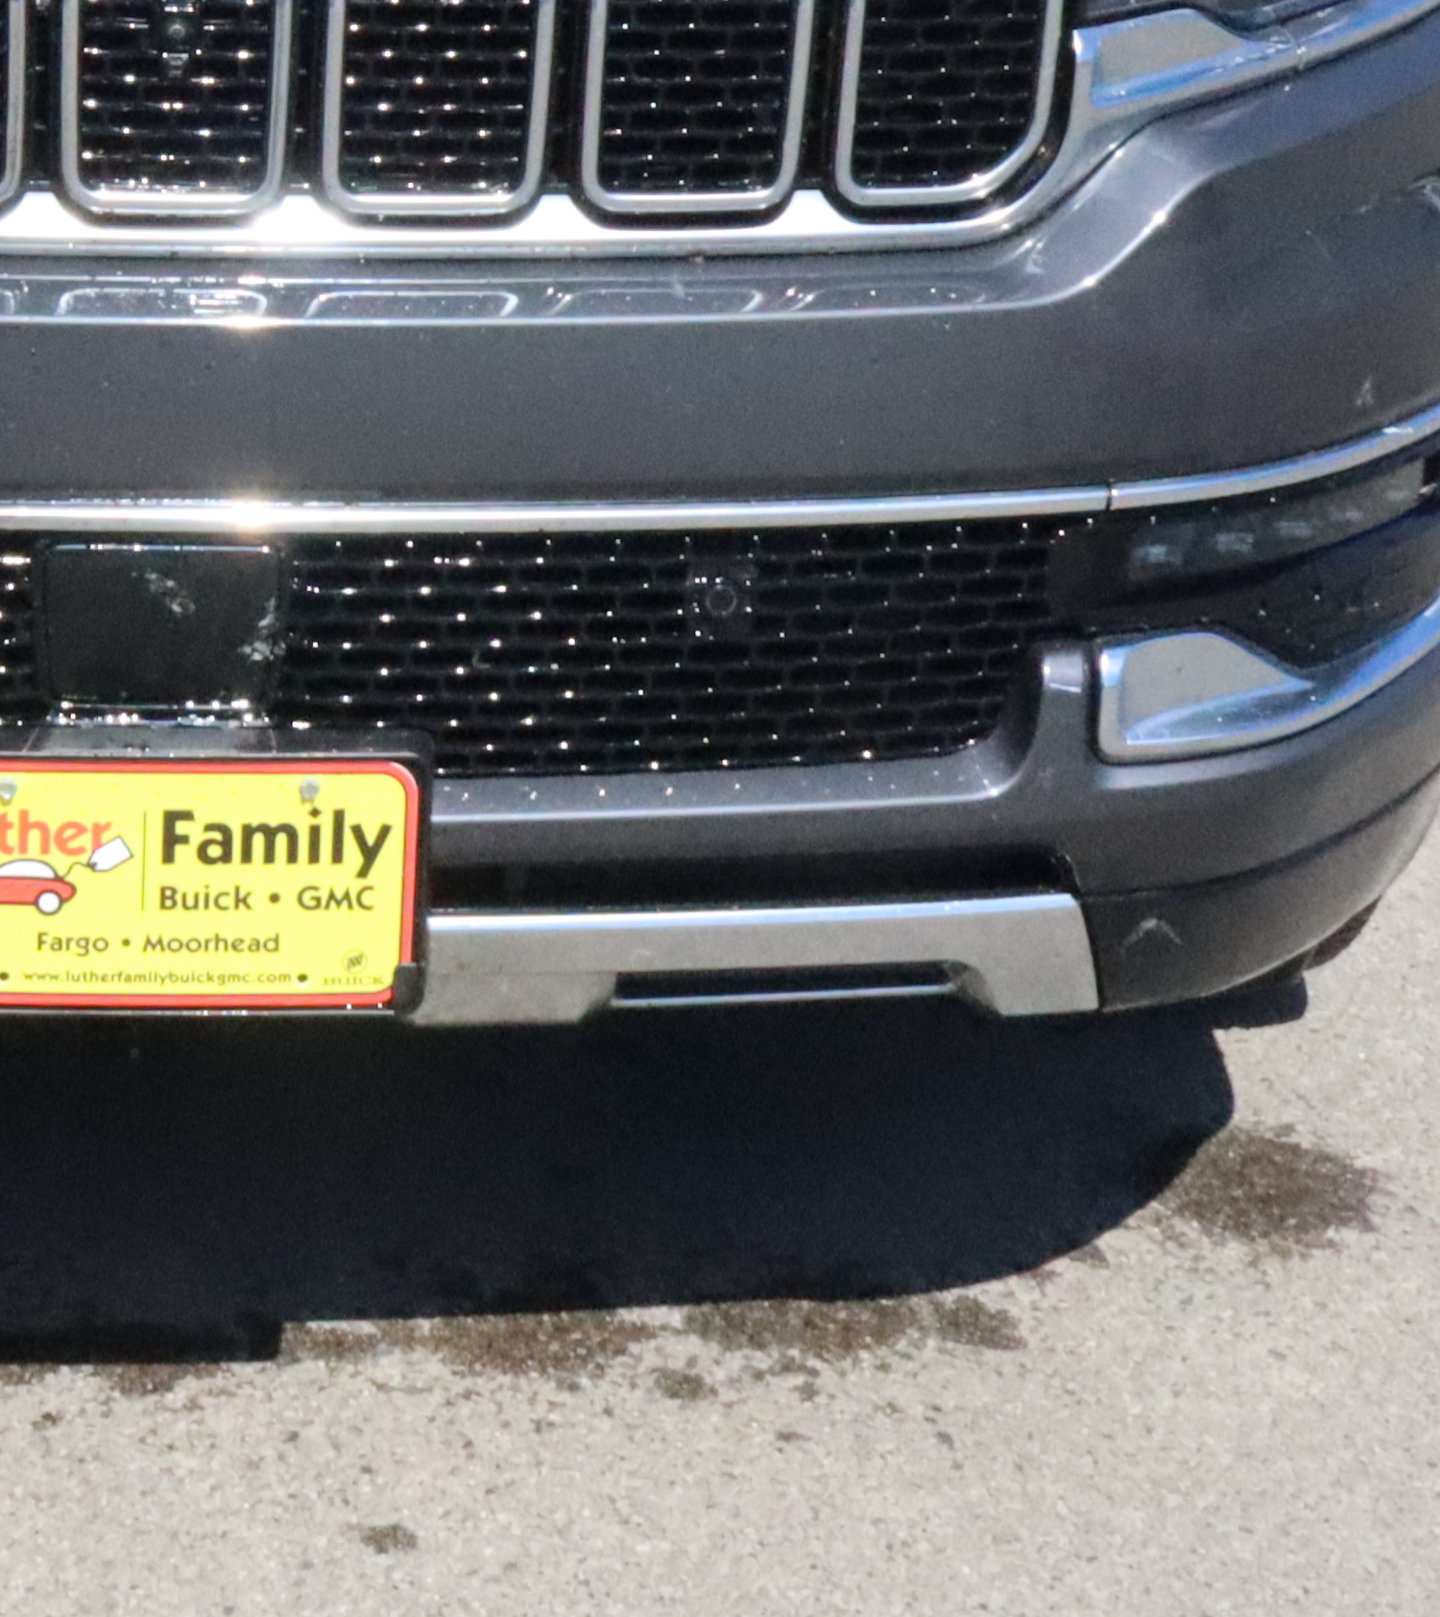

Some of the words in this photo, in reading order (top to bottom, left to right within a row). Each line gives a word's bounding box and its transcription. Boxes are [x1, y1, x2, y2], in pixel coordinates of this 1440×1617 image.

[162, 806, 393, 879] Family
[158, 885, 253, 912] Buick
[297, 886, 376, 912] GMC
[36, 933, 110, 957] Fargo
[142, 933, 280, 954] Moorhead
[23, 970, 293, 986] www.lutherfamilybuickgmc.com
